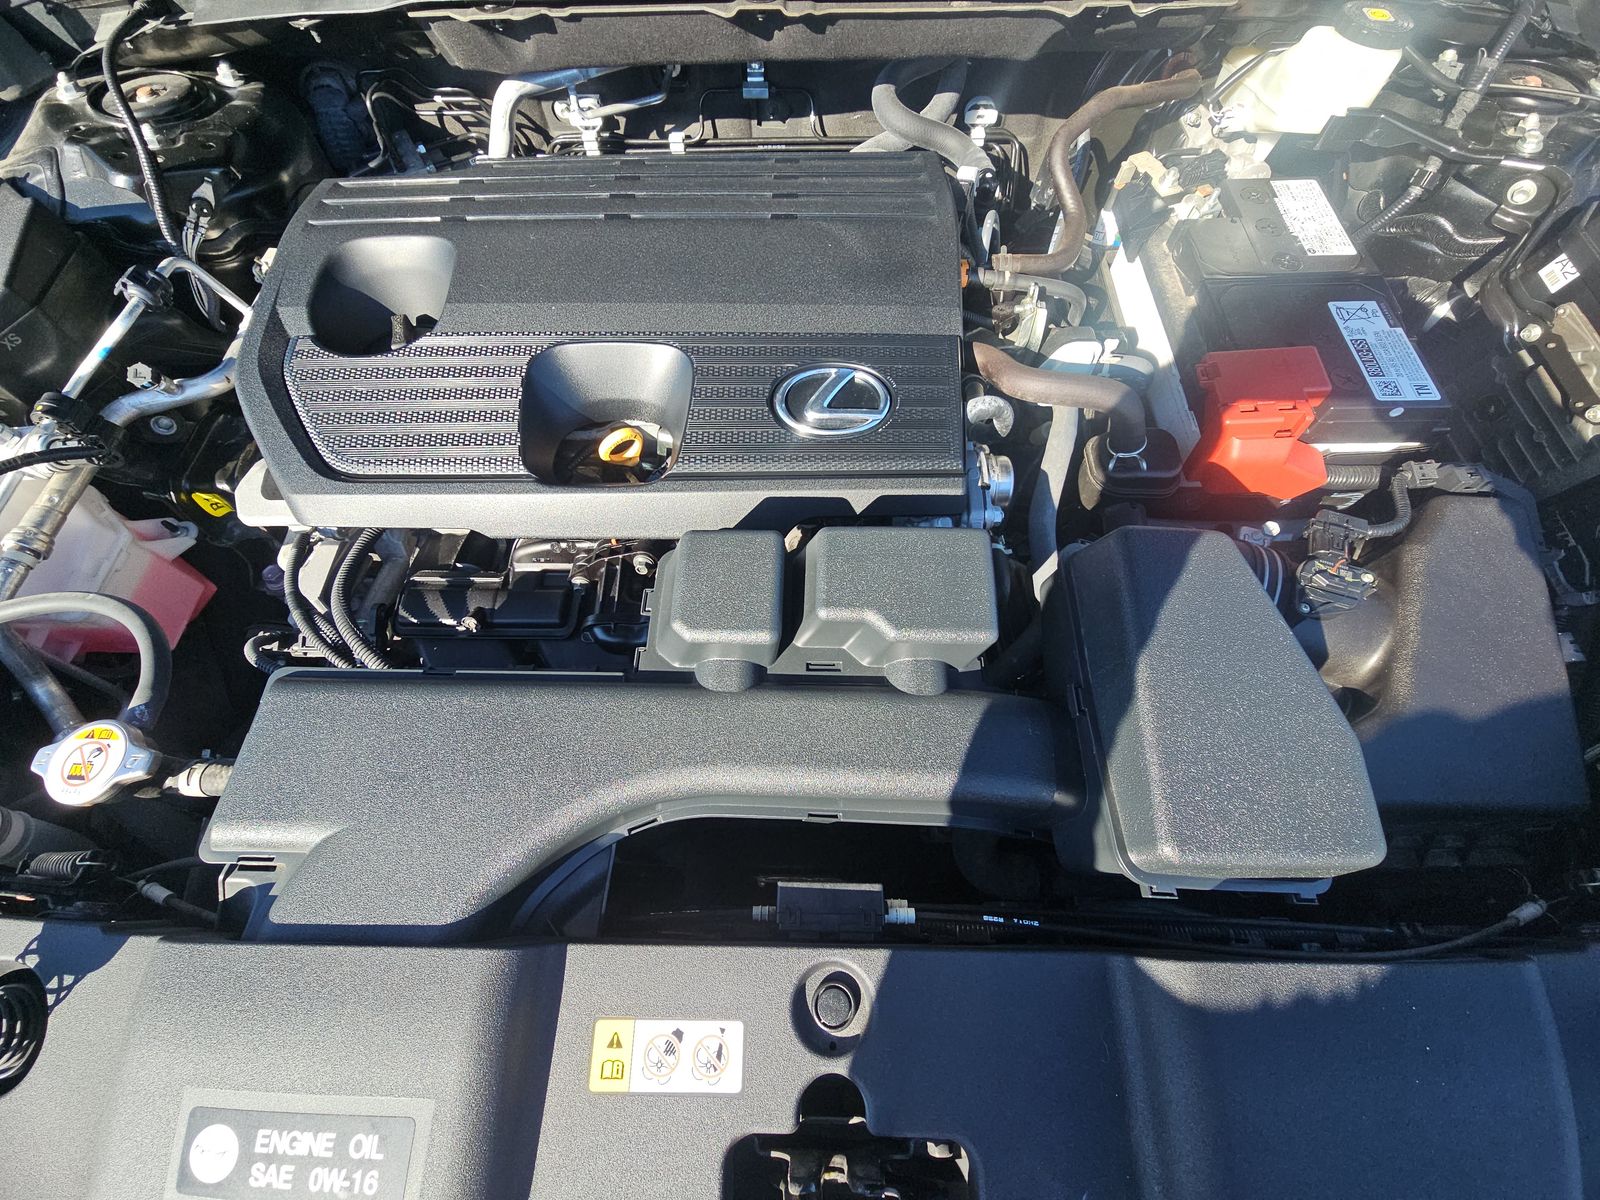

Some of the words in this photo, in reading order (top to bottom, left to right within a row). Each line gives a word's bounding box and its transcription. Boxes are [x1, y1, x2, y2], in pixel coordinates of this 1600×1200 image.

[1554, 258, 1578, 281] A2
[1413, 384, 1433, 397] TN
[254, 1128, 336, 1158] ENGINE
[348, 1133, 384, 1160] OIL
[248, 1162, 295, 1190] SAE
[308, 1166, 379, 1196] 0W-16
